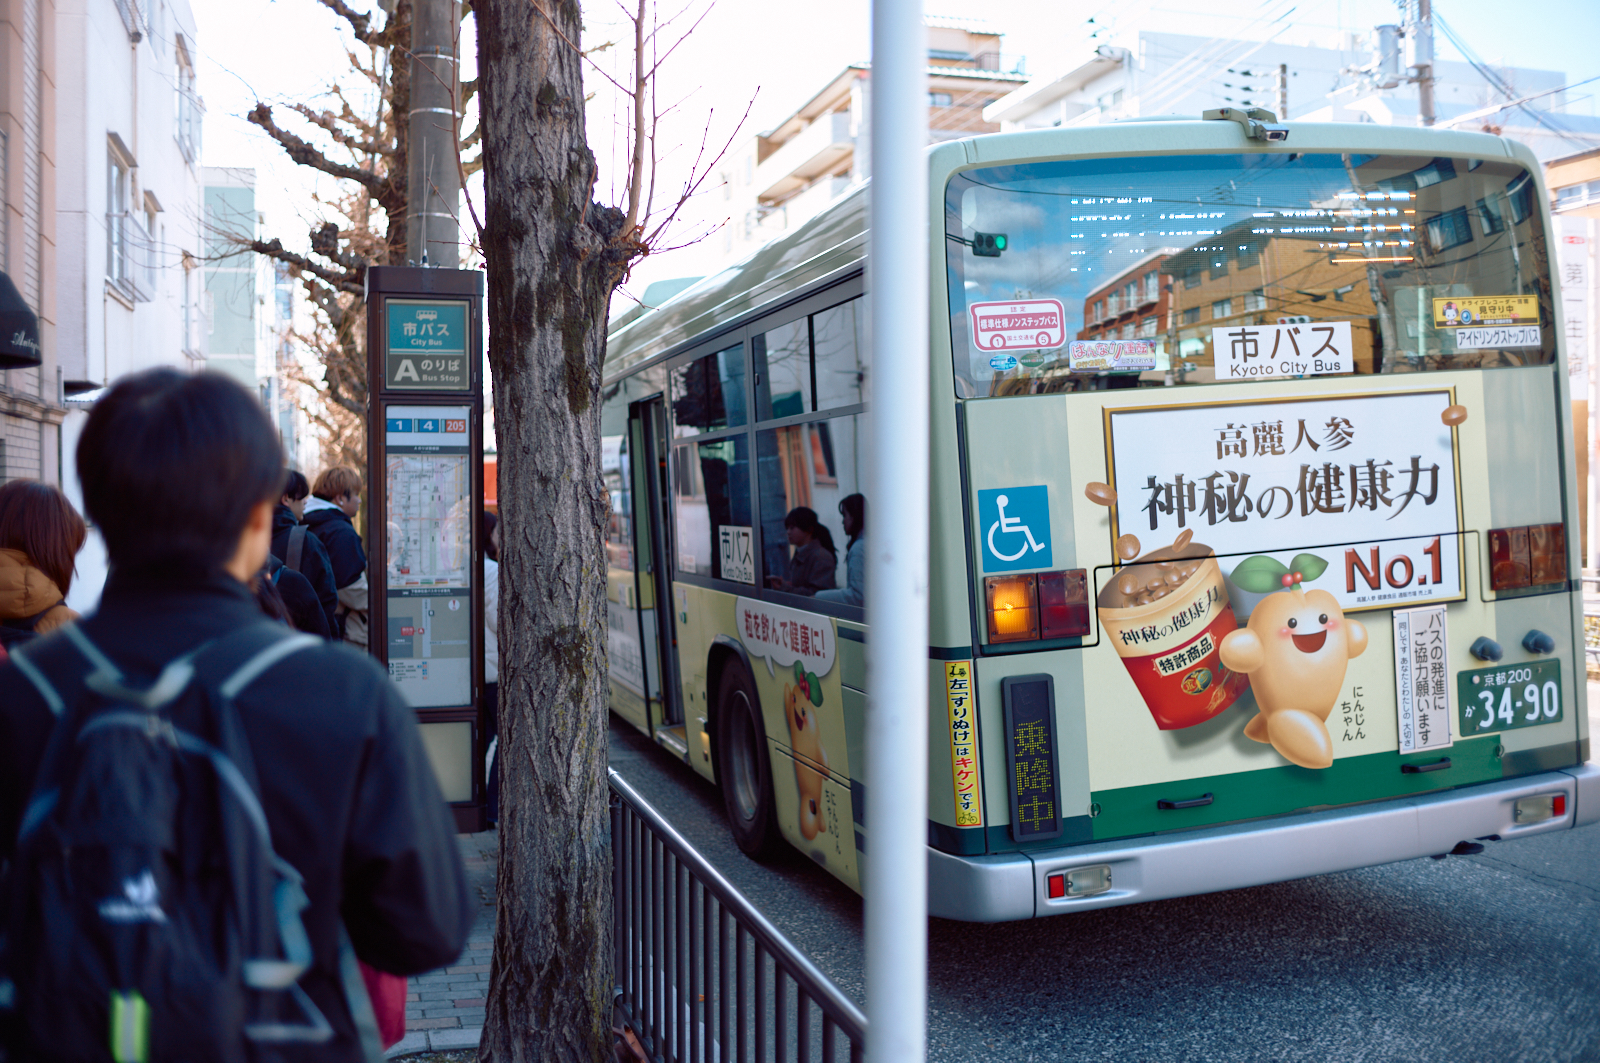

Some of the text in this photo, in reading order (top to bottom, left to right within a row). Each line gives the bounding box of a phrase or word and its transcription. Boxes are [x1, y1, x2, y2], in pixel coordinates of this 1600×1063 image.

[980, 316, 1057, 329] 標準仕様ノンステップバス
[1479, 305, 1514, 314] 見守り中
[403, 322, 450, 336] 市バス
[411, 338, 427, 347] City
[1007, 334, 1034, 342] 国土交通省
[1458, 329, 1539, 346] アイドリングストップバス
[1071, 342, 1149, 361] はんなり運転
[1228, 327, 1339, 363] 市バス
[394, 359, 420, 382] A
[421, 359, 461, 371] のりば
[440, 374, 460, 383] Stop
[1230, 360, 1341, 377] Kyoto City Bus
[395, 420, 403, 430] 1
[423, 421, 434, 430] 4
[446, 421, 465, 431] 205
[1214, 416, 1355, 459] 高麗人参
[1141, 455, 1440, 530] 神秘の健康力
[721, 528, 752, 565] 市バス
[723, 565, 753, 581] Kyoto City Bus
[1345, 535, 1443, 593] No.1
[1119, 586, 1218, 645] 神秘の健康力
[744, 609, 826, 659] 粒を飲んで健康に!
[1398, 622, 1407, 653] 同じです
[1159, 637, 1213, 673] 特許商品
[1429, 612, 1445, 711] バスの発進に
[1400, 657, 1410, 719] あなたとわたしの
[1414, 629, 1431, 745] ご協力願います
[1484, 668, 1531, 686] 京都200
[1353, 686, 1366, 740] にんじん
[1465, 681, 1559, 728] か 34-90
[1341, 701, 1353, 741] ちゃん
[949, 678, 977, 813] 左「すりぬけ」はキケンです。
[1014, 719, 1053, 831] 乗降中
